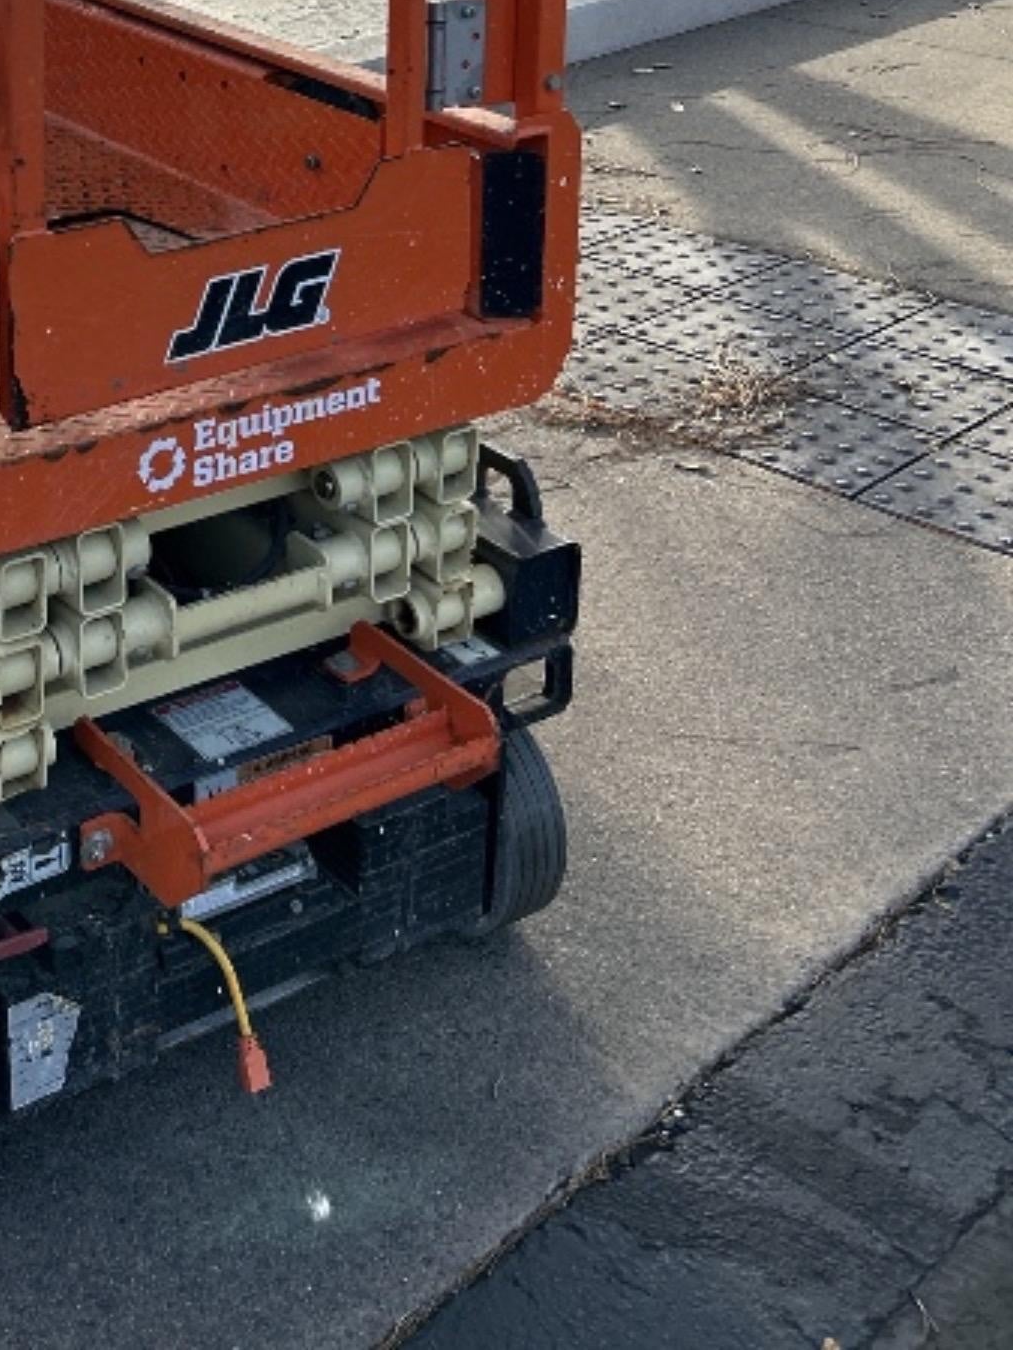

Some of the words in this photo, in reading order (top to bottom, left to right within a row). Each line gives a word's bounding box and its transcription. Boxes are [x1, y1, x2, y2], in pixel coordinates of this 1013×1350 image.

[164, 248, 341, 365] JLG
[194, 377, 381, 451] Equipment
[193, 440, 294, 488] Share
